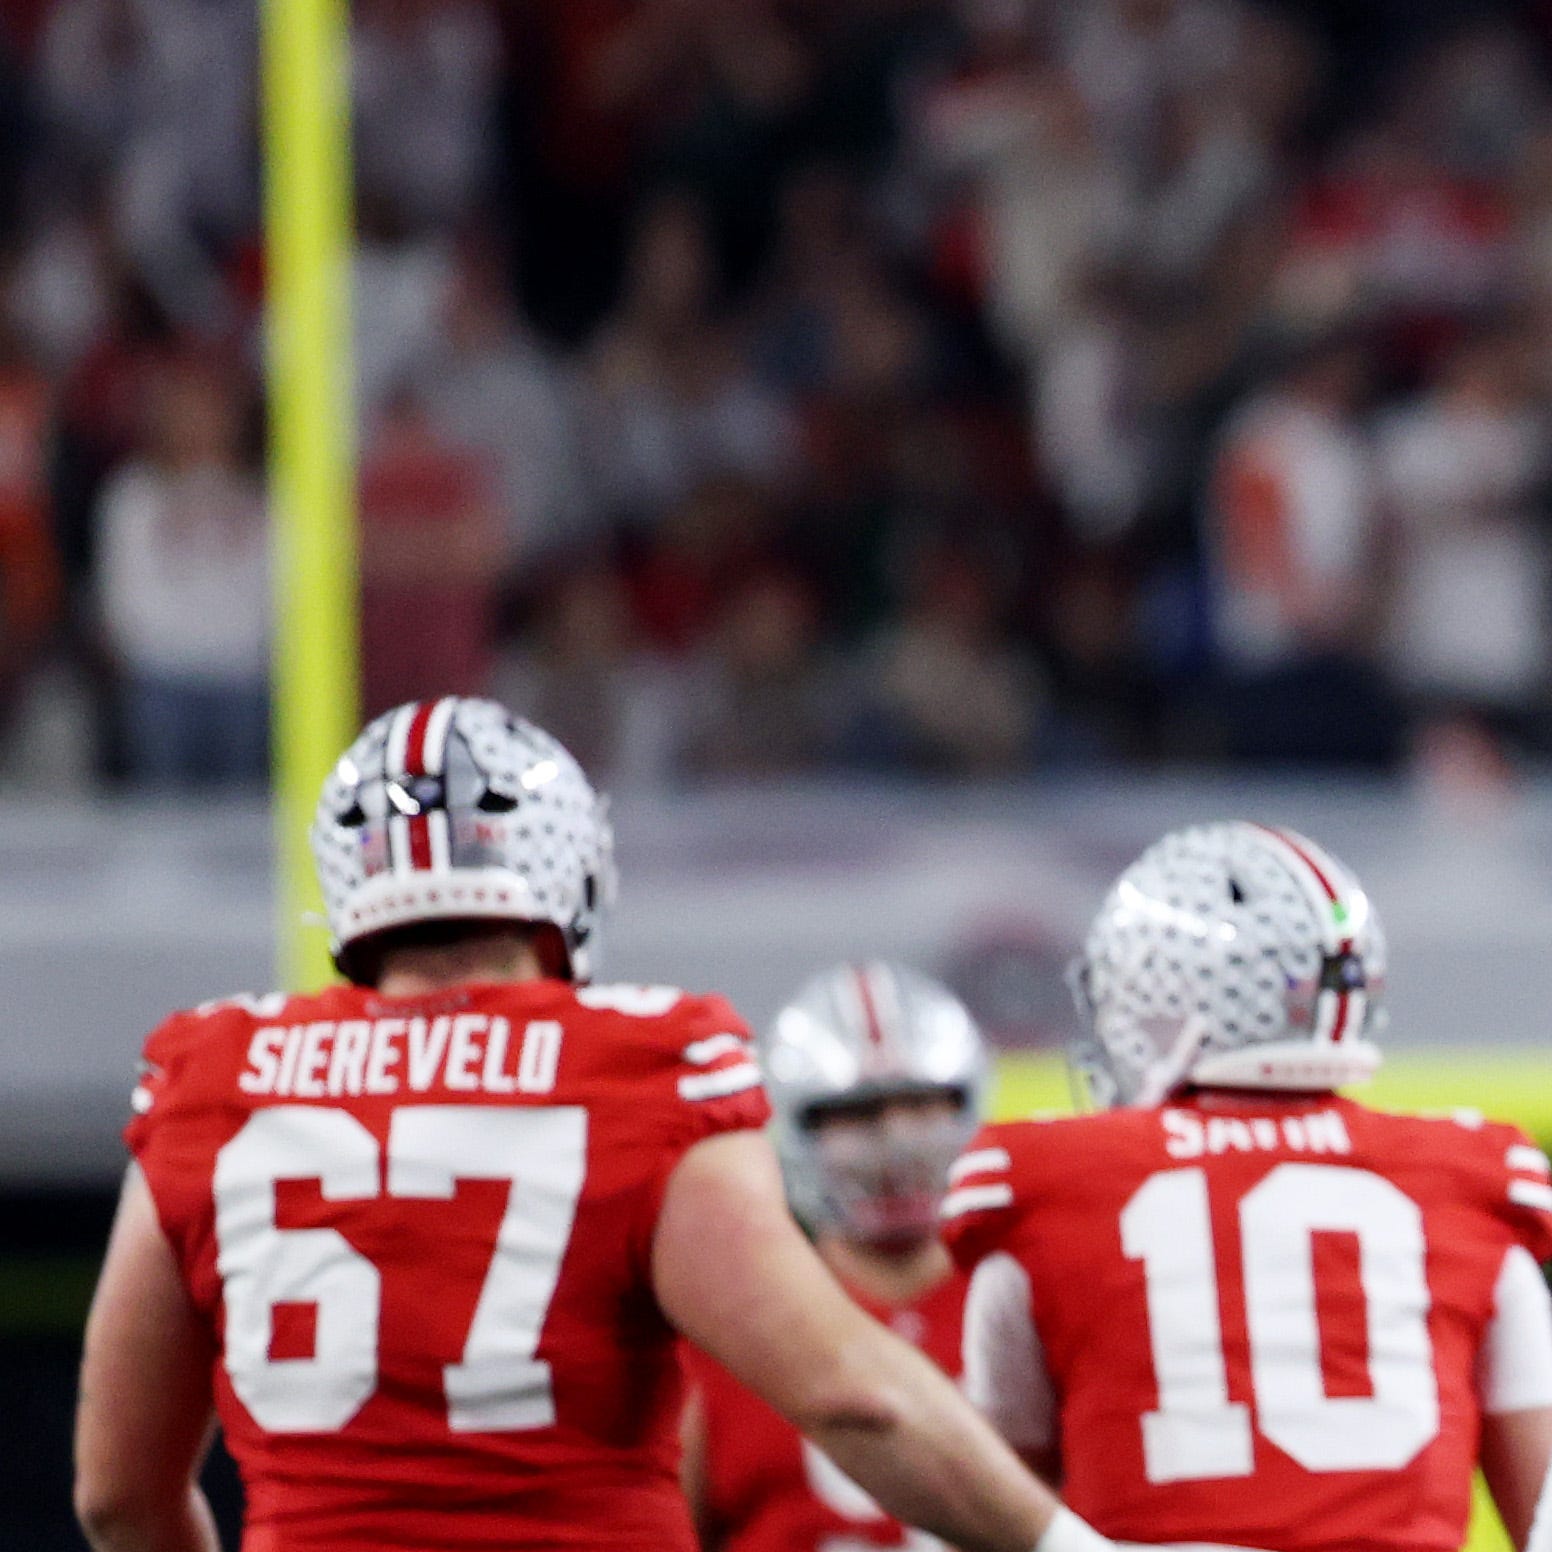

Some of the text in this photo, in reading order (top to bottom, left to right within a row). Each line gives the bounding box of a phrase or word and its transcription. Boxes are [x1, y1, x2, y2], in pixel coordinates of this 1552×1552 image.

[238, 1013, 563, 1099] SIEREVELD
[213, 1104, 588, 1434] 67
[1118, 1162, 1440, 1484] 10
